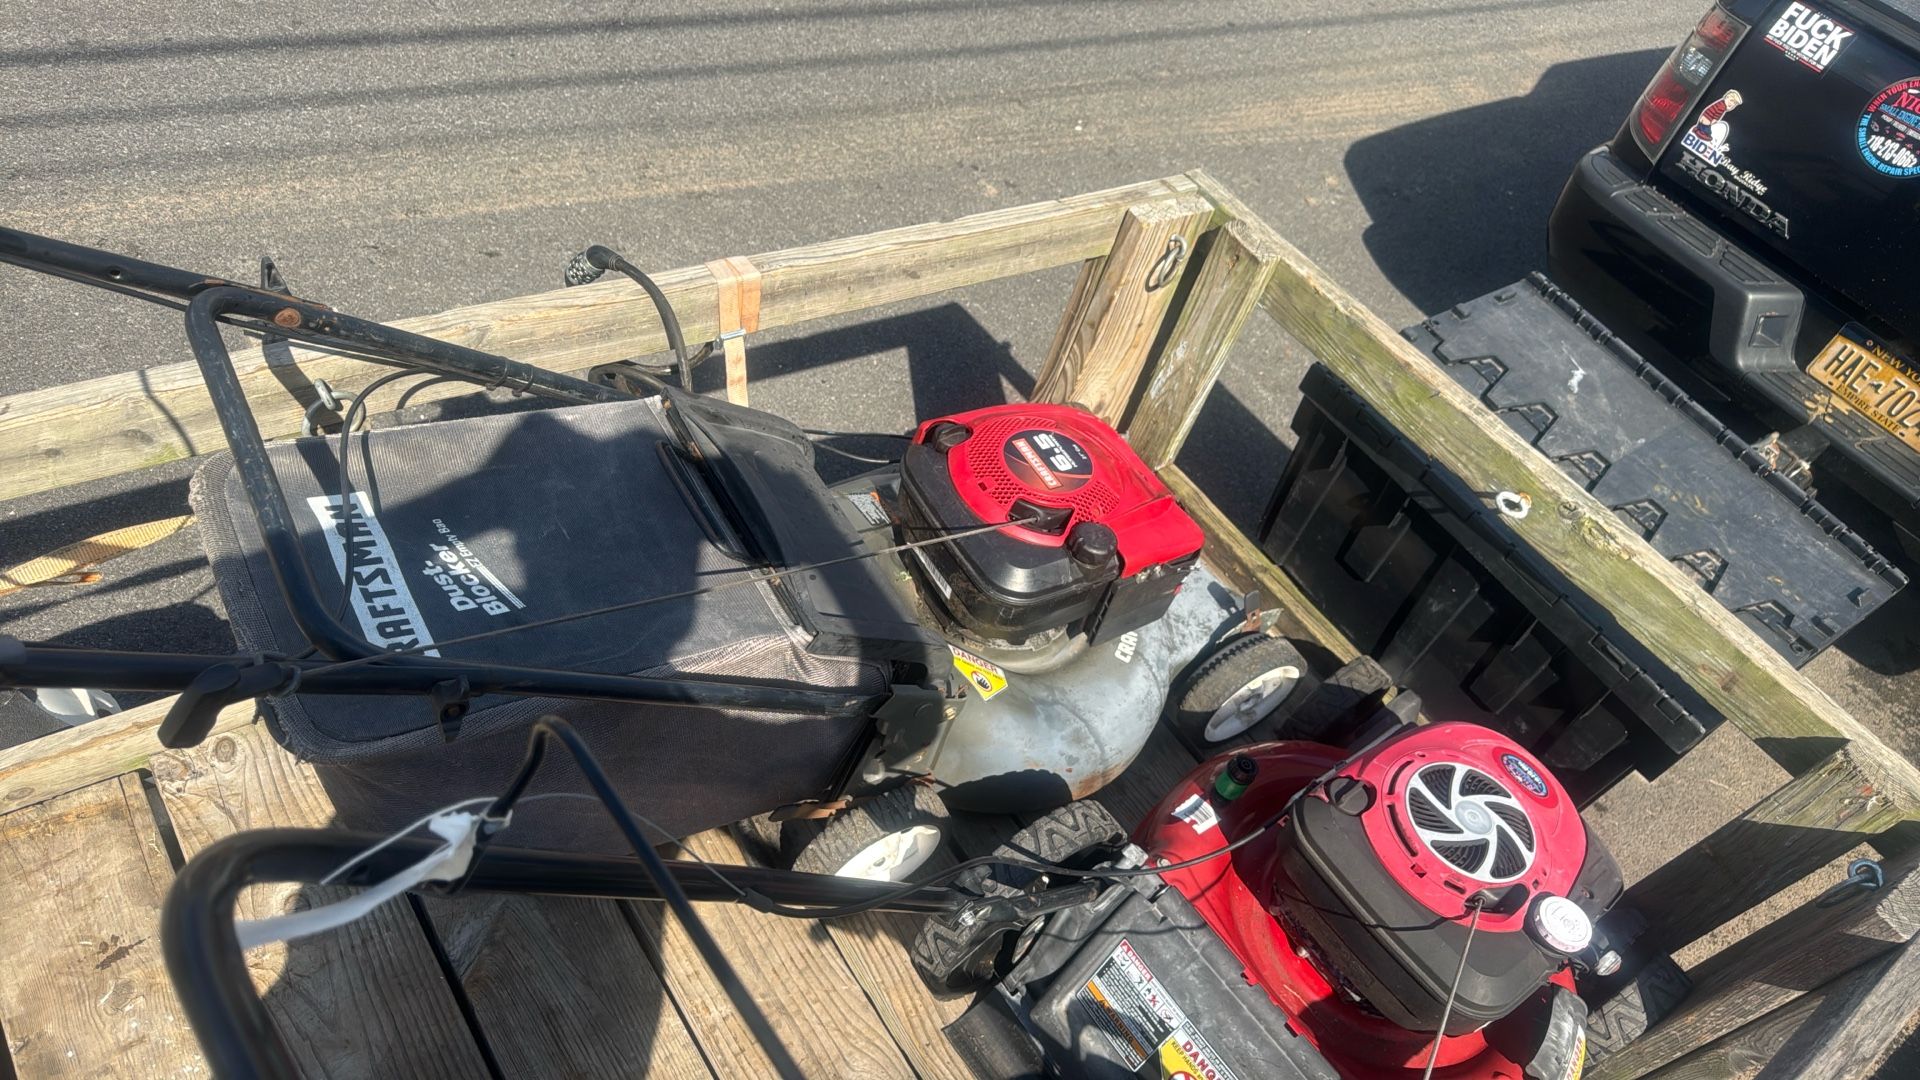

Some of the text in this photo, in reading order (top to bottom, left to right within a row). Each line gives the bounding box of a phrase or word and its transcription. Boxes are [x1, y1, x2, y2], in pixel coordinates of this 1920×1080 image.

[1769, 18, 1838, 66] BIDEN
[1782, 1, 1853, 50] FUCK
[1867, 93, 1888, 112] WHEN
[1887, 83, 1908, 95] YOUR
[1858, 127, 1867, 149] SMALL
[1860, 112, 1873, 127] THE
[1683, 133, 1722, 165] BIDEN
[1861, 147, 1880, 168] ENGINE
[1721, 156, 1768, 193] Bay Ridge
[1879, 162, 1903, 176] REPAIR
[1675, 151, 1790, 240] HONDA
[1824, 343, 1881, 394] HAE
[1872, 345, 1920, 385] NEW YO
[1836, 384, 1900, 434] EMPIRE STATE
[1016, 440, 1059, 487] CRAFTSMAN
[1033, 432, 1074, 472] 6.5
[446, 534, 474, 558] Empty
[324, 503, 420, 652] RAFTSMAN
[429, 543, 512, 617] Blocker
[951, 647, 998, 675] DANGER
[1127, 949, 1152, 980] DANGER
[1106, 1005, 1134, 1044] WARNING
[1171, 1042, 1184, 1056] KEEP
[1182, 1054, 1199, 1075] HANDS
[1182, 1040, 1222, 1080] DANG
